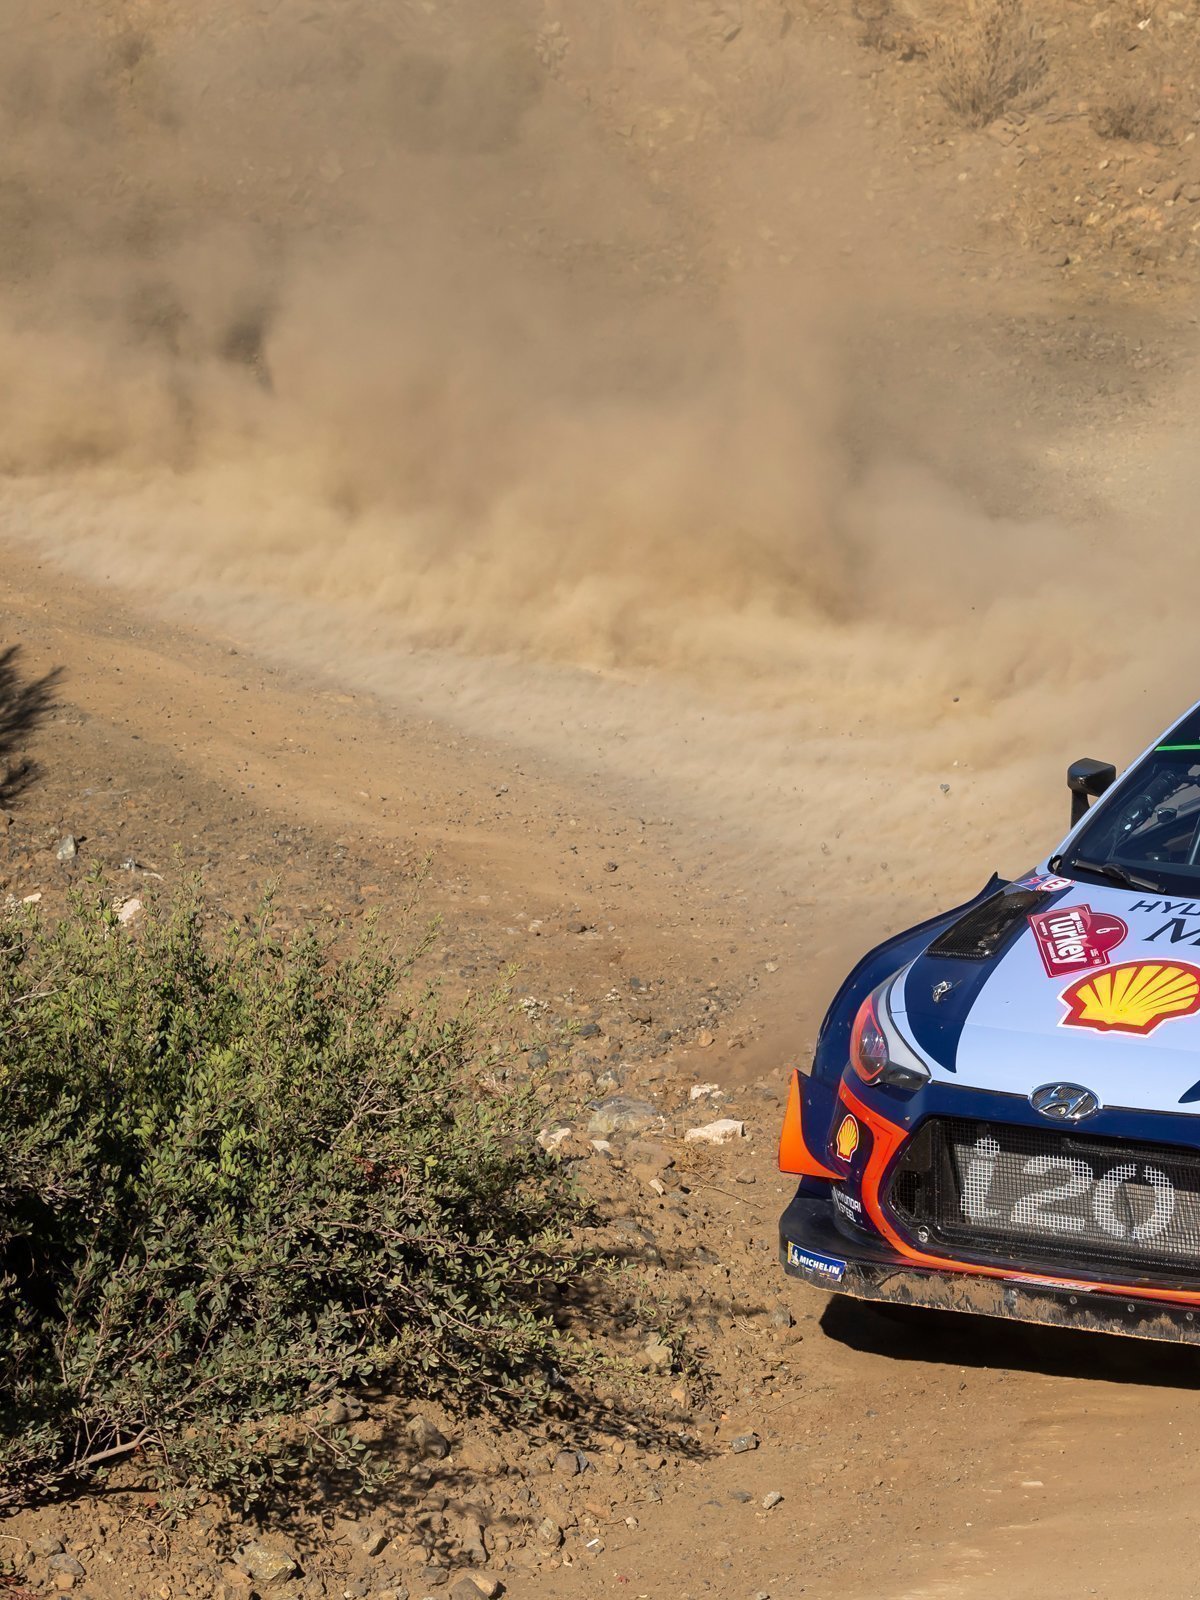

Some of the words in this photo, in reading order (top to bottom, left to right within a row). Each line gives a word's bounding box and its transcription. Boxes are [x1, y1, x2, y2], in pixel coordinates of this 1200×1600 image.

[1048, 911, 1088, 964] Turkey
[960, 1136, 1176, 1241] i20
[800, 1255, 840, 1275] MICHELIN
